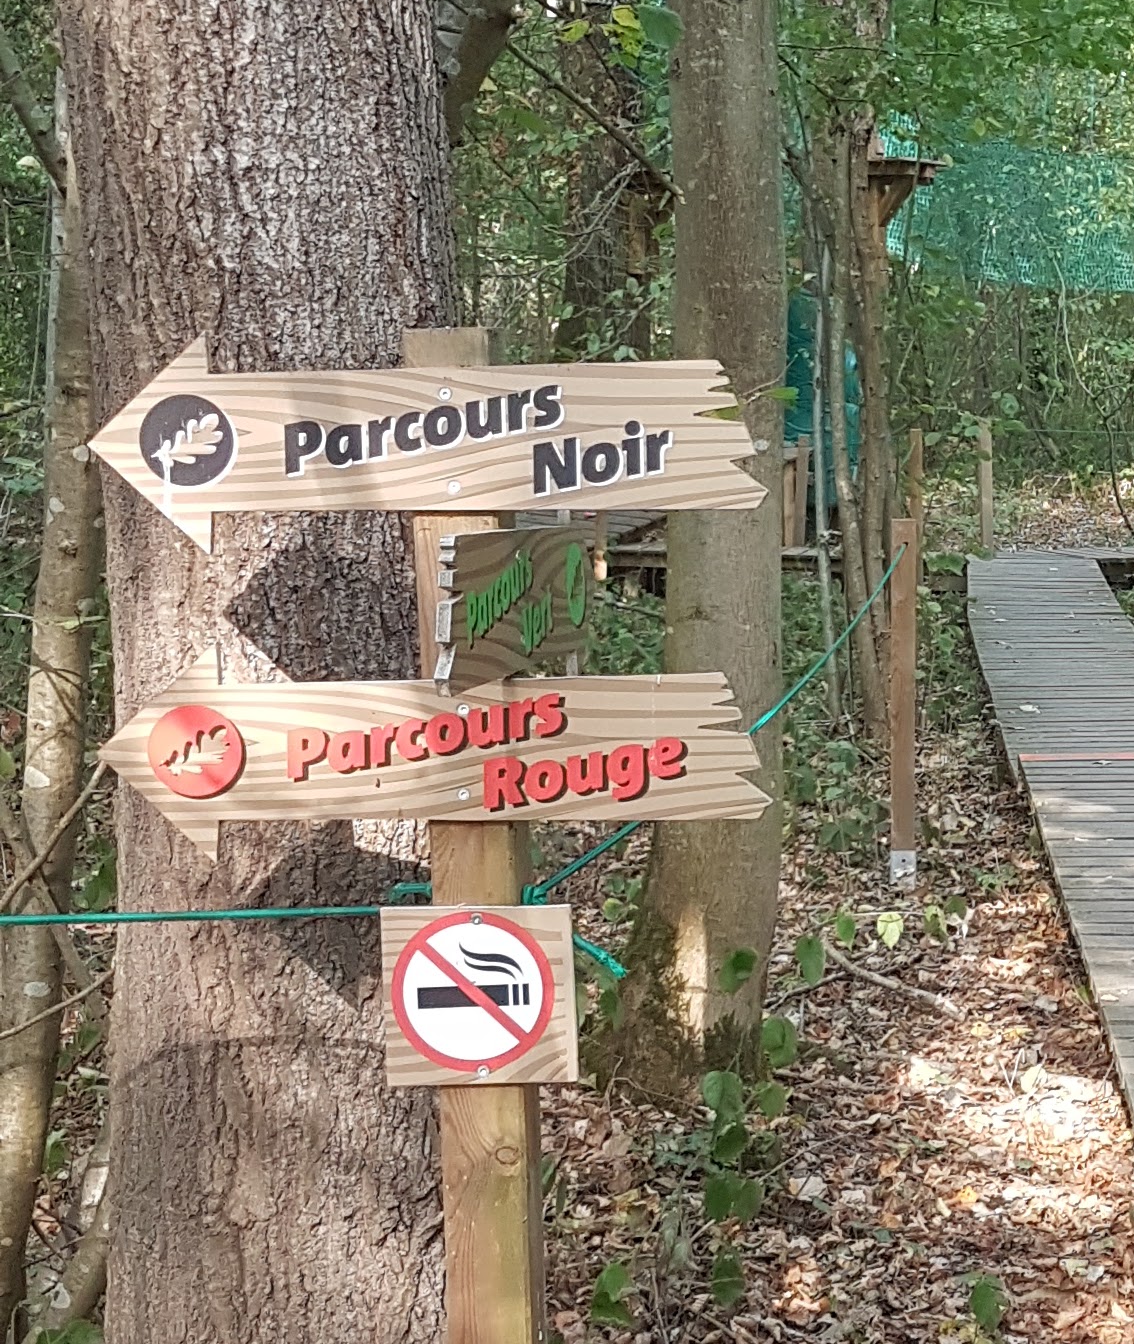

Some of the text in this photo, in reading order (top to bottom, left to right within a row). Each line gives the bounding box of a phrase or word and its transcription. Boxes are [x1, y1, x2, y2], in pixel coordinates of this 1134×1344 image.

[284, 384, 563, 477] Parcours
[533, 420, 673, 497] Noir
[467, 550, 533, 649] Parcours
[521, 586, 553, 657] Vert
[287, 692, 566, 782] Parcours
[483, 737, 687, 811] Rouge
